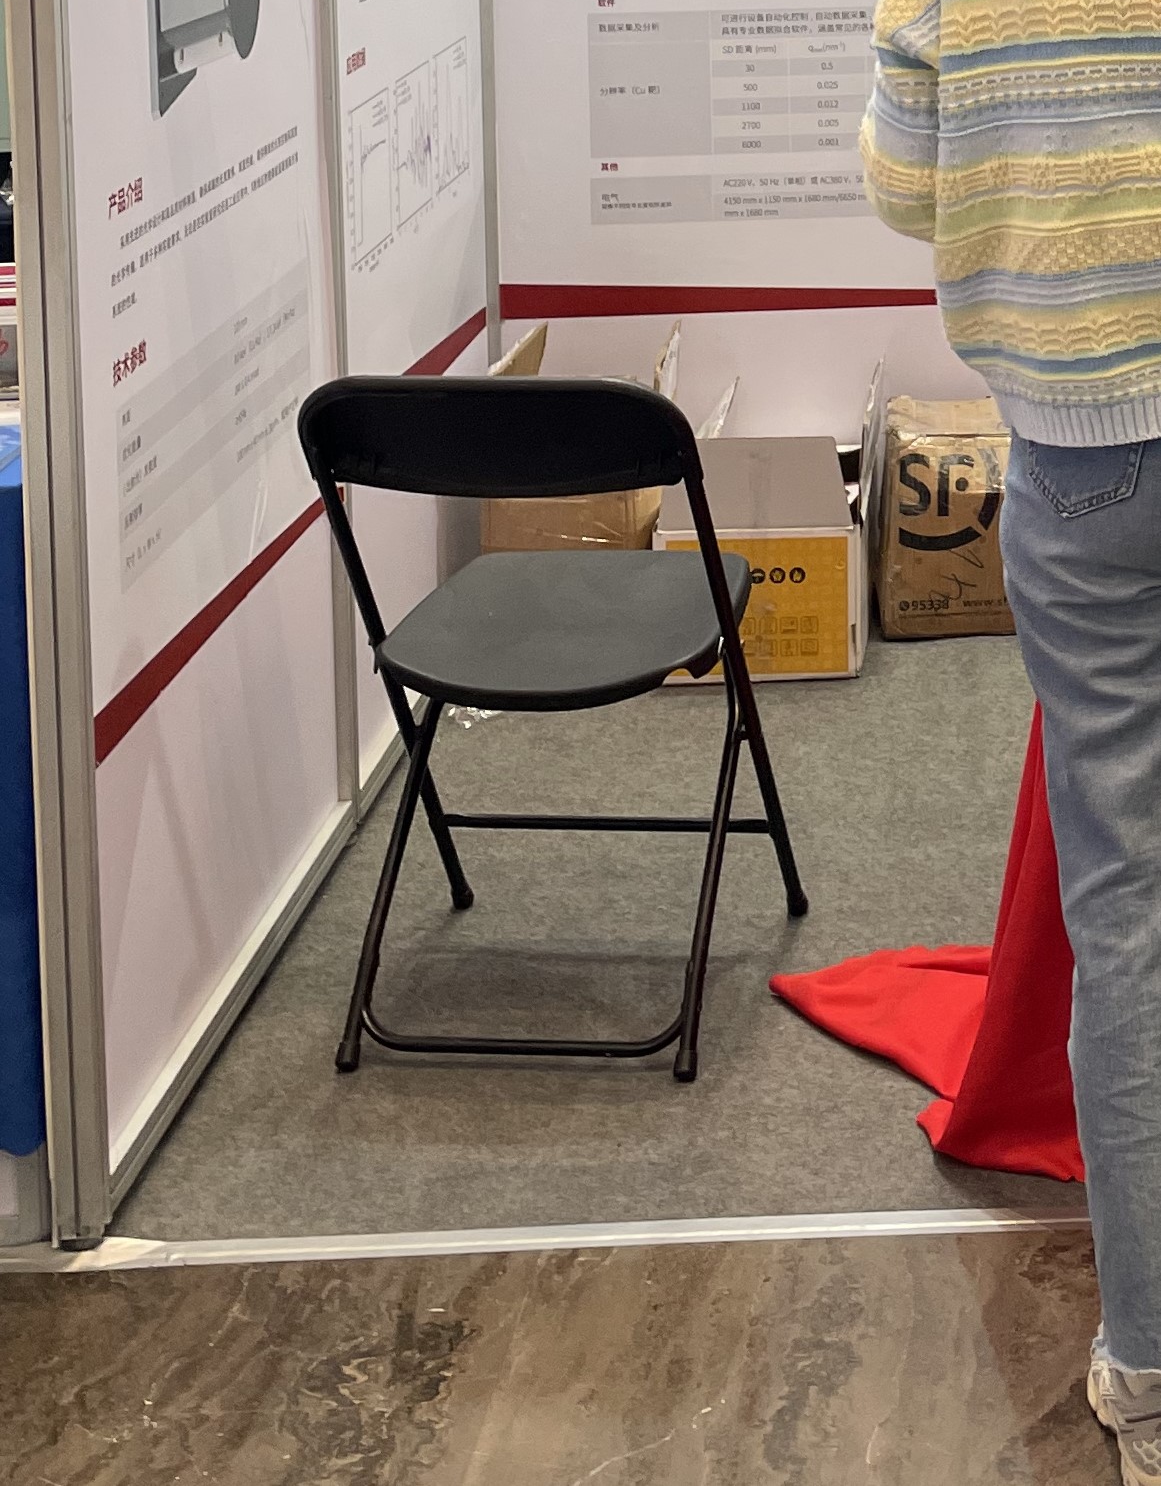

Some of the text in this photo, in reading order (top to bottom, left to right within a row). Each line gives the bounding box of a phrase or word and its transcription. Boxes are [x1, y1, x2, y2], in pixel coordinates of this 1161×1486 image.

[108, 176, 144, 220] 产品介绍
[112, 338, 148, 388] 技术参数
